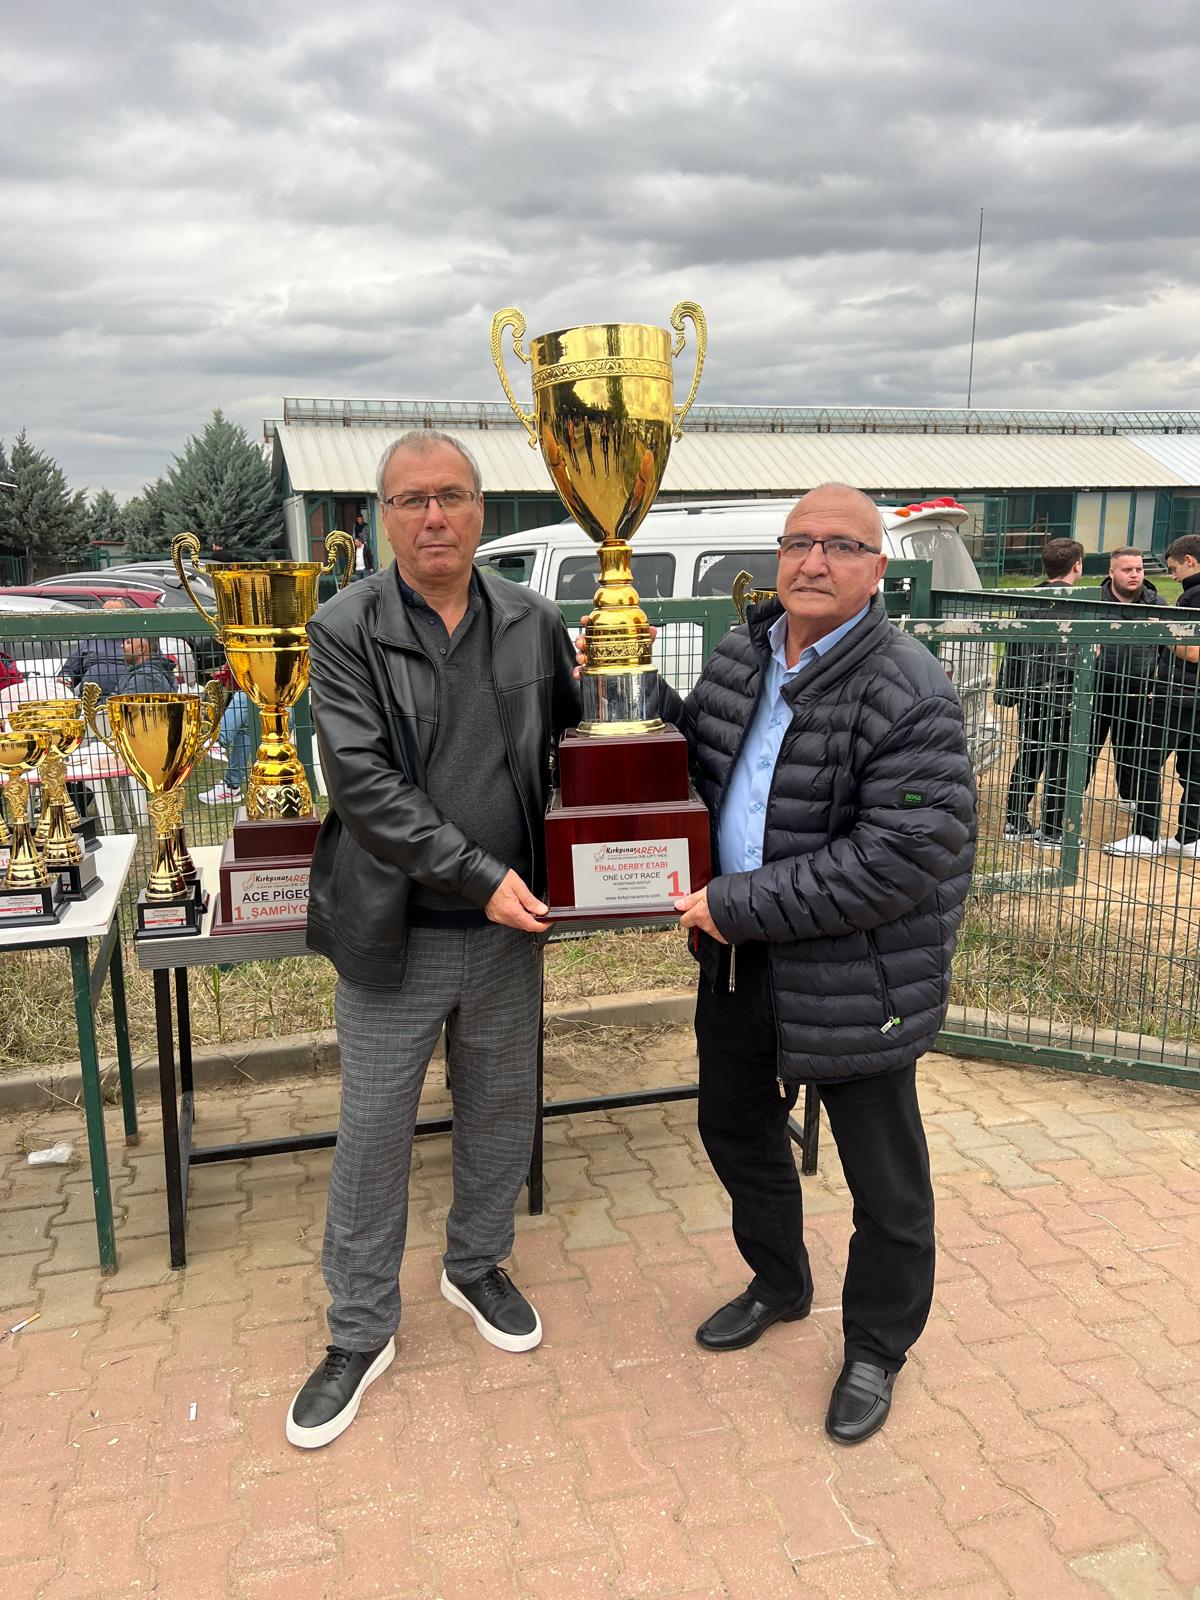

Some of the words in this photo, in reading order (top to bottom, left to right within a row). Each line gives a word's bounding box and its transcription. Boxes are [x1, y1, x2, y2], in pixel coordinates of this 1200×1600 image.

[594, 863, 617, 872] FINAL
[618, 862, 644, 871] DERBY
[646, 861, 668, 869] ETABI
[602, 874, 619, 882] ONE
[620, 872, 639, 881] LOFT
[640, 871, 660, 879] RACE
[242, 892, 269, 902] ACE
